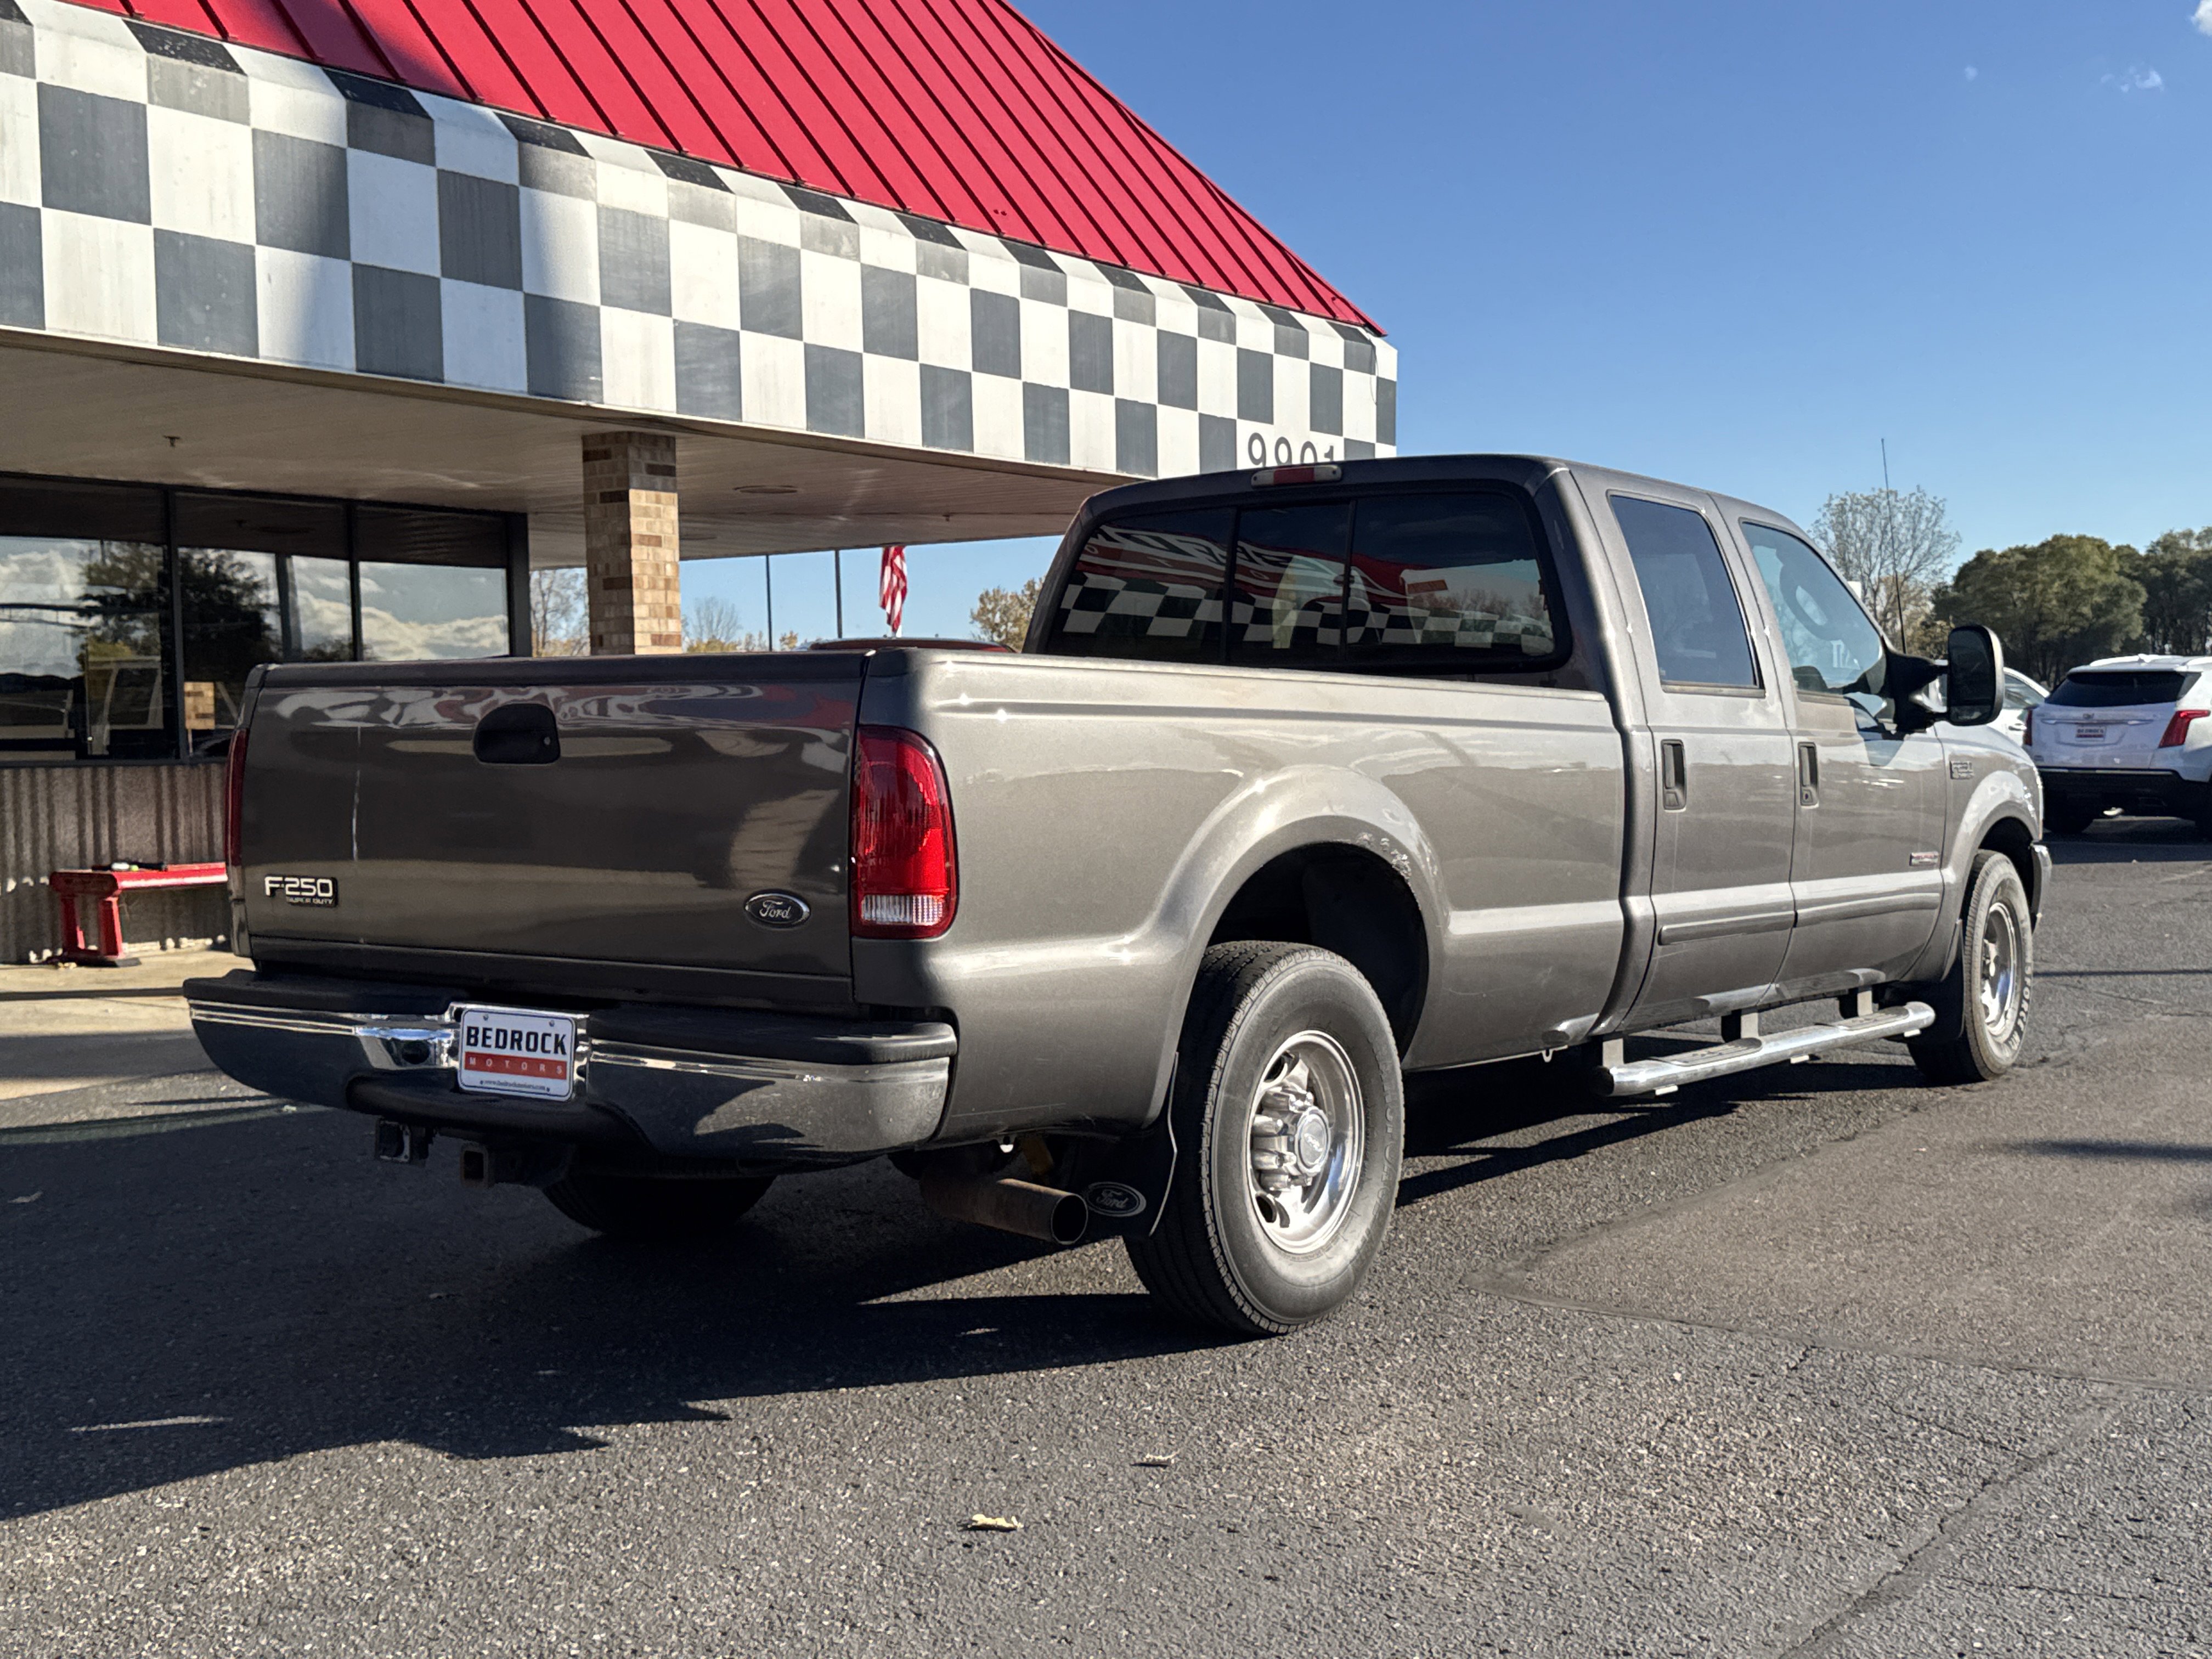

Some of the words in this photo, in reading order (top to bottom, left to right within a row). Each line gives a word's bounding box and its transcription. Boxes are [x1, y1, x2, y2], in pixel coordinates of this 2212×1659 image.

[759, 900, 791, 919] Ford
[466, 1026, 567, 1055] BEDROCK
[469, 1057, 563, 1075] MOTORS
[1097, 1189, 1129, 1209] Ford
